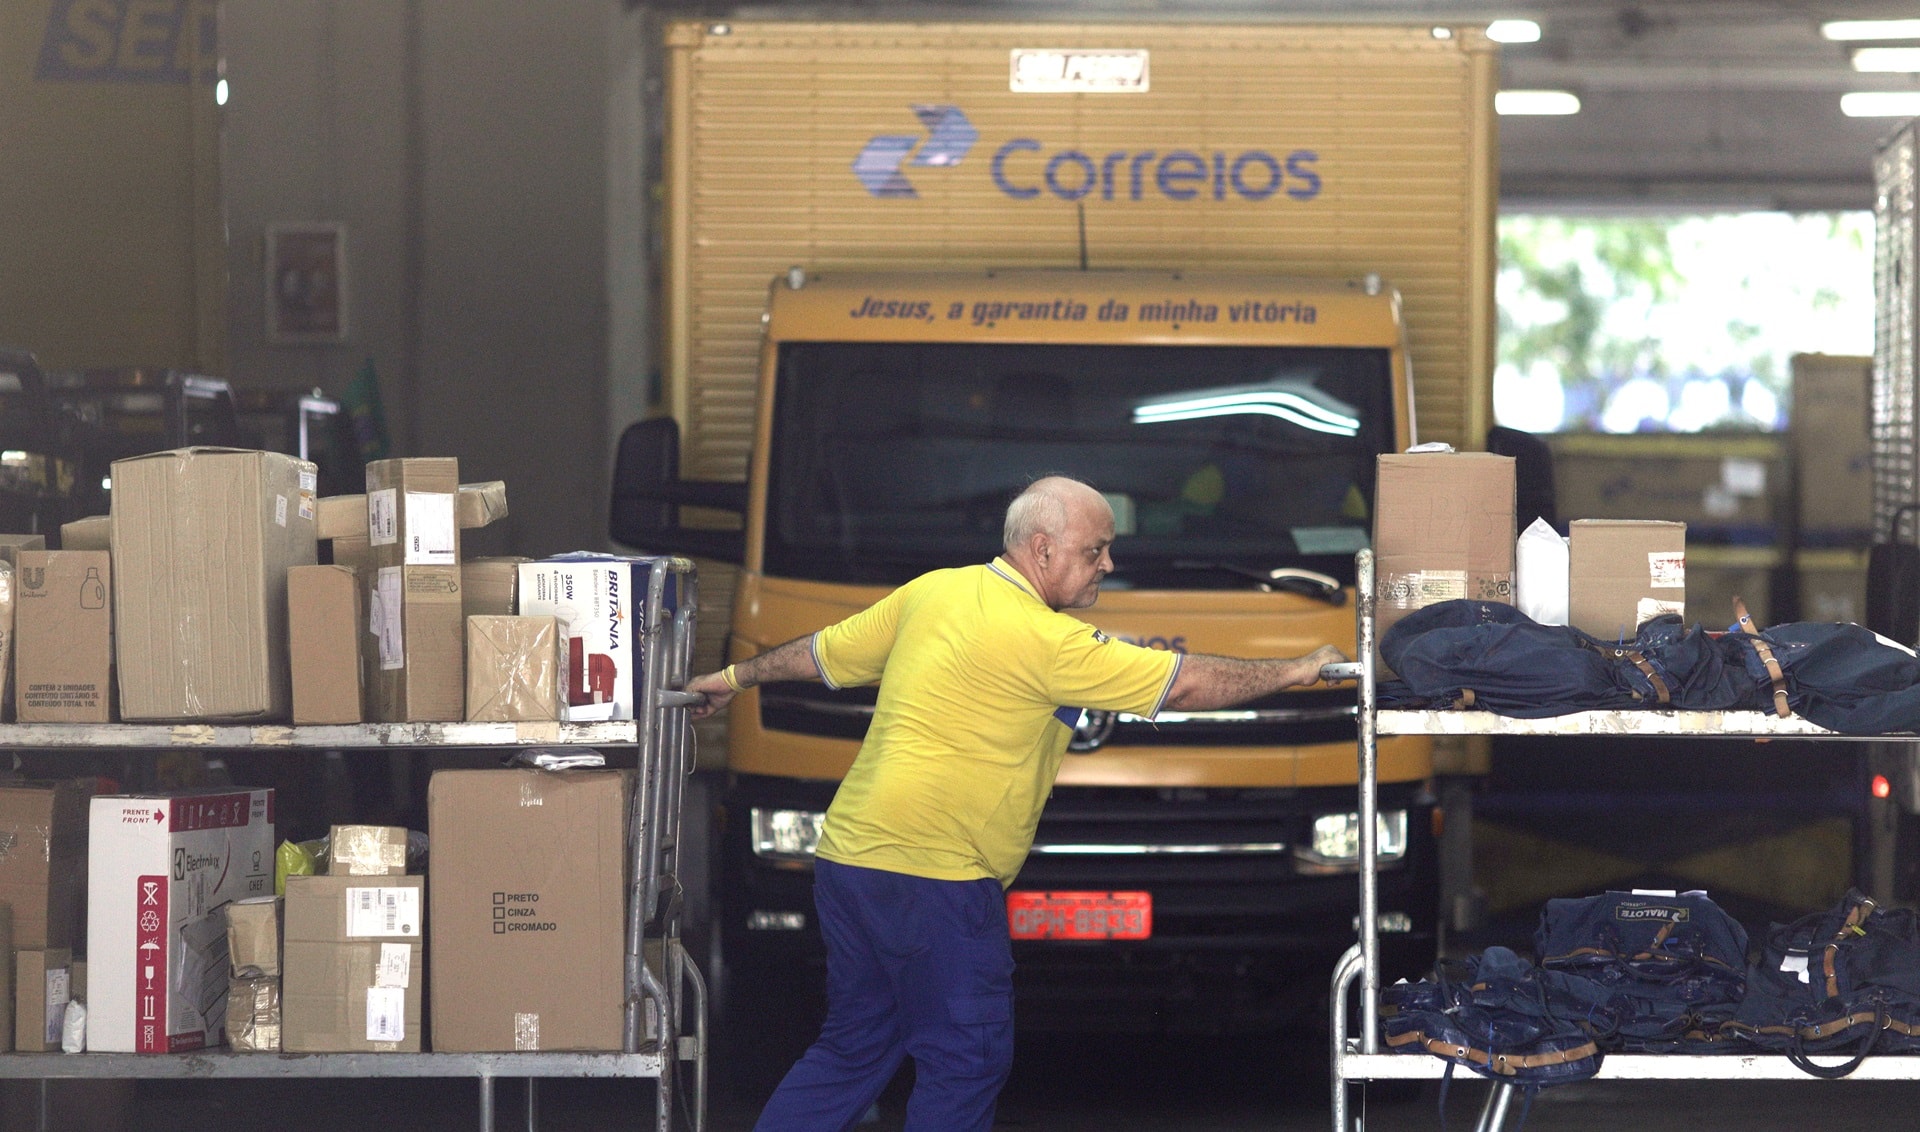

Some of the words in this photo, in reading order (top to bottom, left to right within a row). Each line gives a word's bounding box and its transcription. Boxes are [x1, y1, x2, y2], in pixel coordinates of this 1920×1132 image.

[990, 137, 1322, 201] Correios
[849, 297, 935, 324] Jesus,
[947, 301, 965, 320] a
[972, 299, 1088, 327] garantia
[1097, 299, 1130, 322] da
[1138, 299, 1219, 323] minha
[1229, 300, 1318, 324] vitória
[565, 574, 573, 601] 350W
[62, 683, 96, 691] UNIDADES
[122, 808, 150, 816] FRENTE
[248, 880, 263, 892] CHEF
[507, 893, 539, 902] PRETO
[507, 908, 536, 917] CINZA
[1620, 909, 1669, 918] MALOTE
[507, 922, 557, 931] CROMADO
